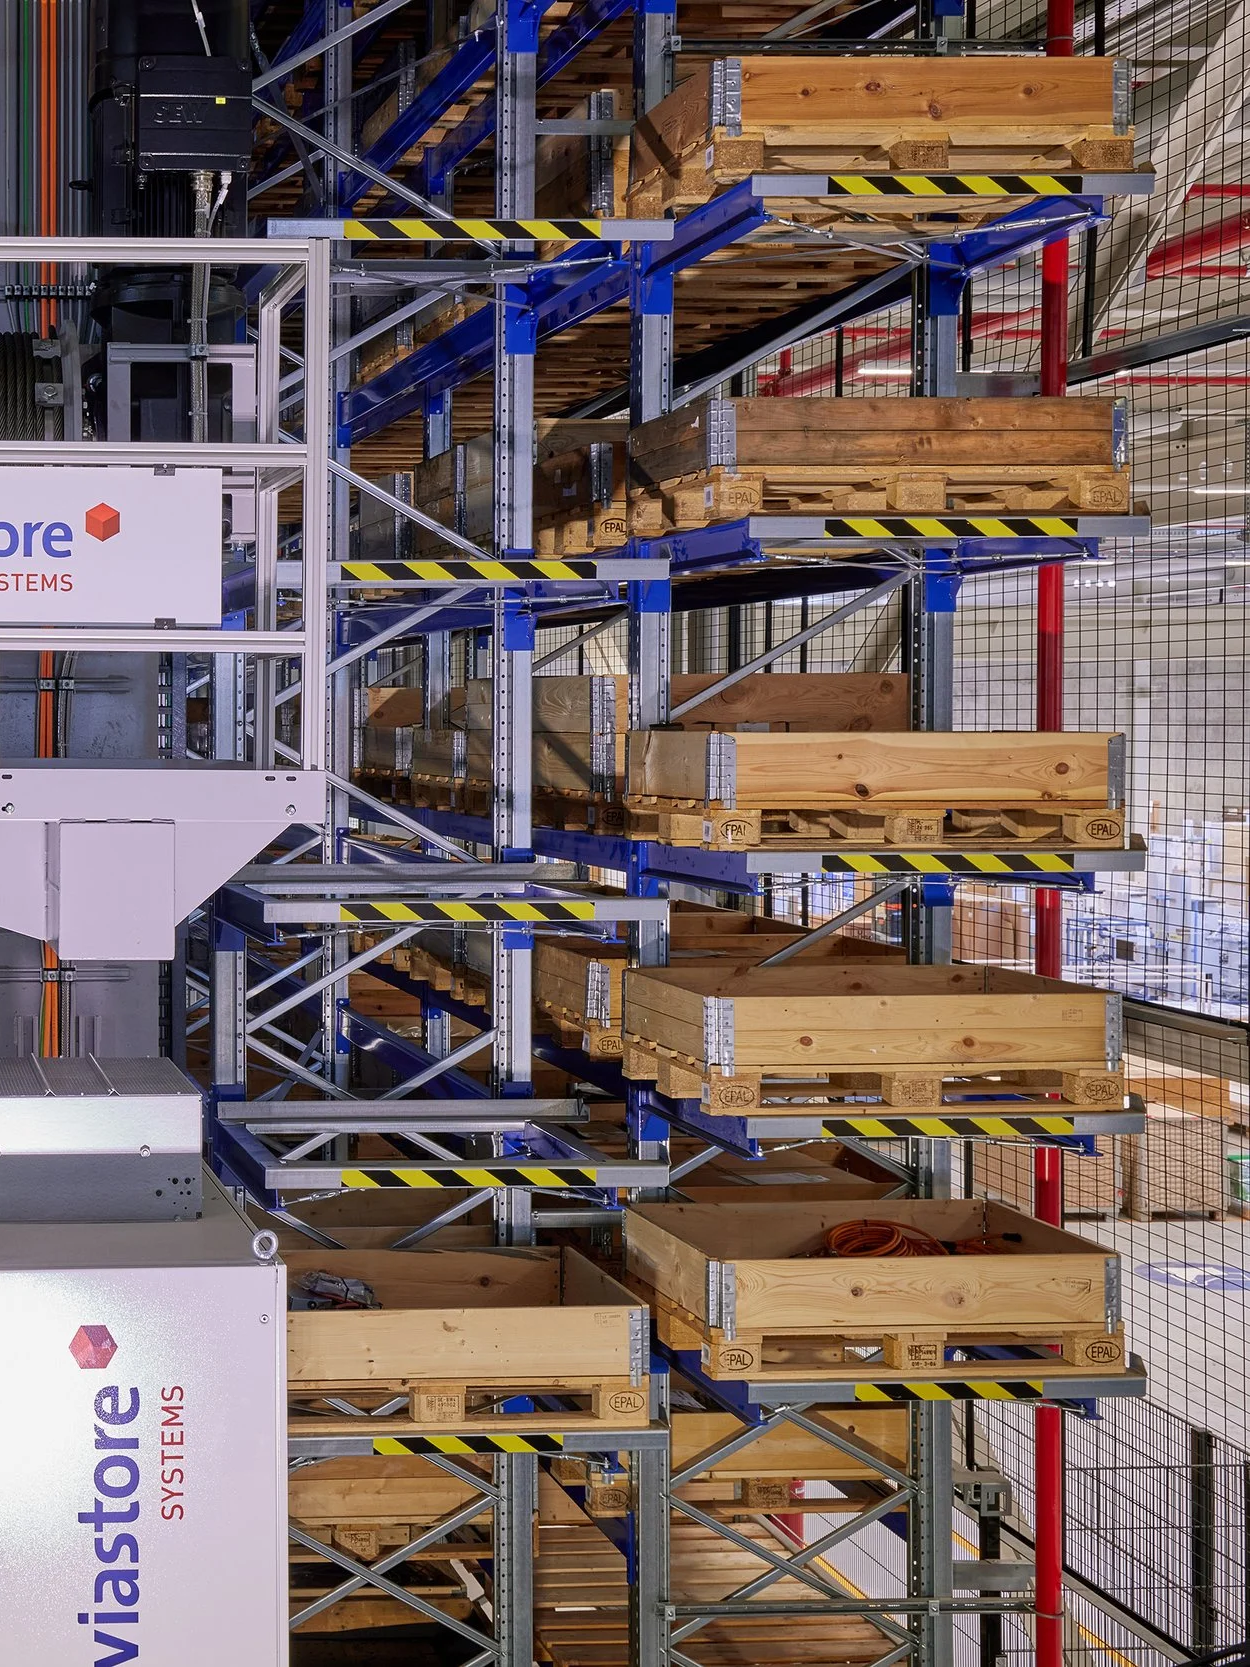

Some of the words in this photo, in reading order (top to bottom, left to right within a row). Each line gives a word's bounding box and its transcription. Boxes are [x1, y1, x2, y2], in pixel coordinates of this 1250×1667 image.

[153, 102, 209, 123] SEW
[728, 491, 755, 504] EPAL
[1093, 491, 1119, 503] EPAL
[604, 522, 627, 533] EPAL
[1091, 824, 1115, 836] EPAL
[601, 1040, 623, 1051] EPAL
[725, 1090, 749, 1103] EPAL
[1090, 1084, 1114, 1097] EPAL
[1091, 1346, 1115, 1359] EPAL
[614, 1396, 639, 1408] EPAL
[160, 1385, 184, 1520] SYSTEMS
[78, 1385, 141, 1667] viastore
